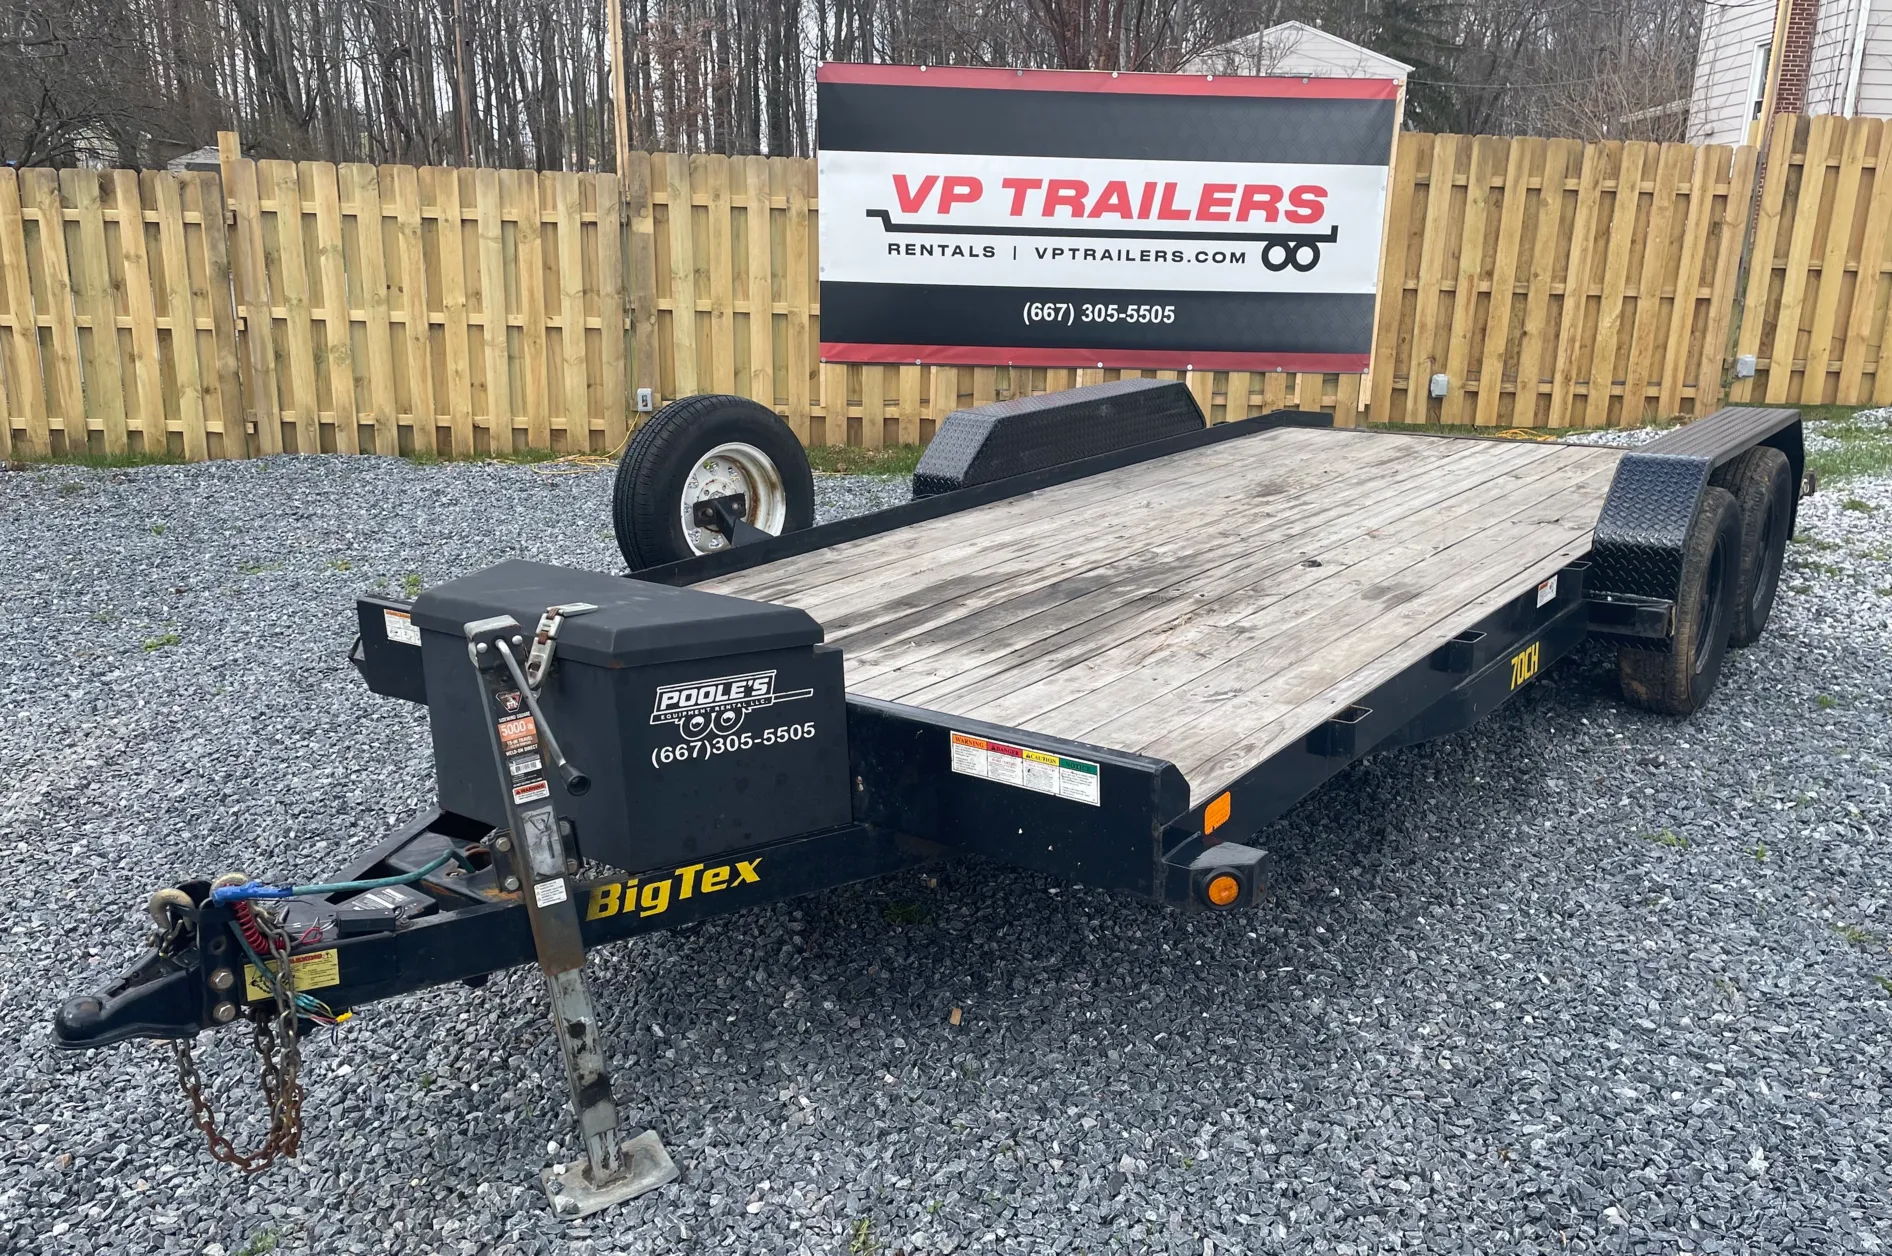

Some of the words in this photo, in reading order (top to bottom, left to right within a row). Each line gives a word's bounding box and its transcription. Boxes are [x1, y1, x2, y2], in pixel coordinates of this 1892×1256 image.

[892, 174, 984, 215] VP
[1001, 178, 1329, 224] TRAILERS
[887, 243, 996, 258] RENTALS
[1034, 247, 1246, 264] VPTRAILERS.COM
[1023, 302, 1075, 326] (667)
[1081, 304, 1175, 324] 305-5505
[1510, 640, 1540, 691] 70CH
[660, 677, 770, 711] POOLE'S
[660, 707, 711, 721] EQUIPMENT
[714, 701, 747, 712] RENTAL
[501, 720, 526, 736] 5000
[651, 721, 816, 769] (667)305-5505
[955, 736, 985, 748] WARNING
[996, 746, 1019, 756] DANGER
[1030, 754, 1057, 764] CAUTION
[1065, 760, 1091, 771] NOTICE
